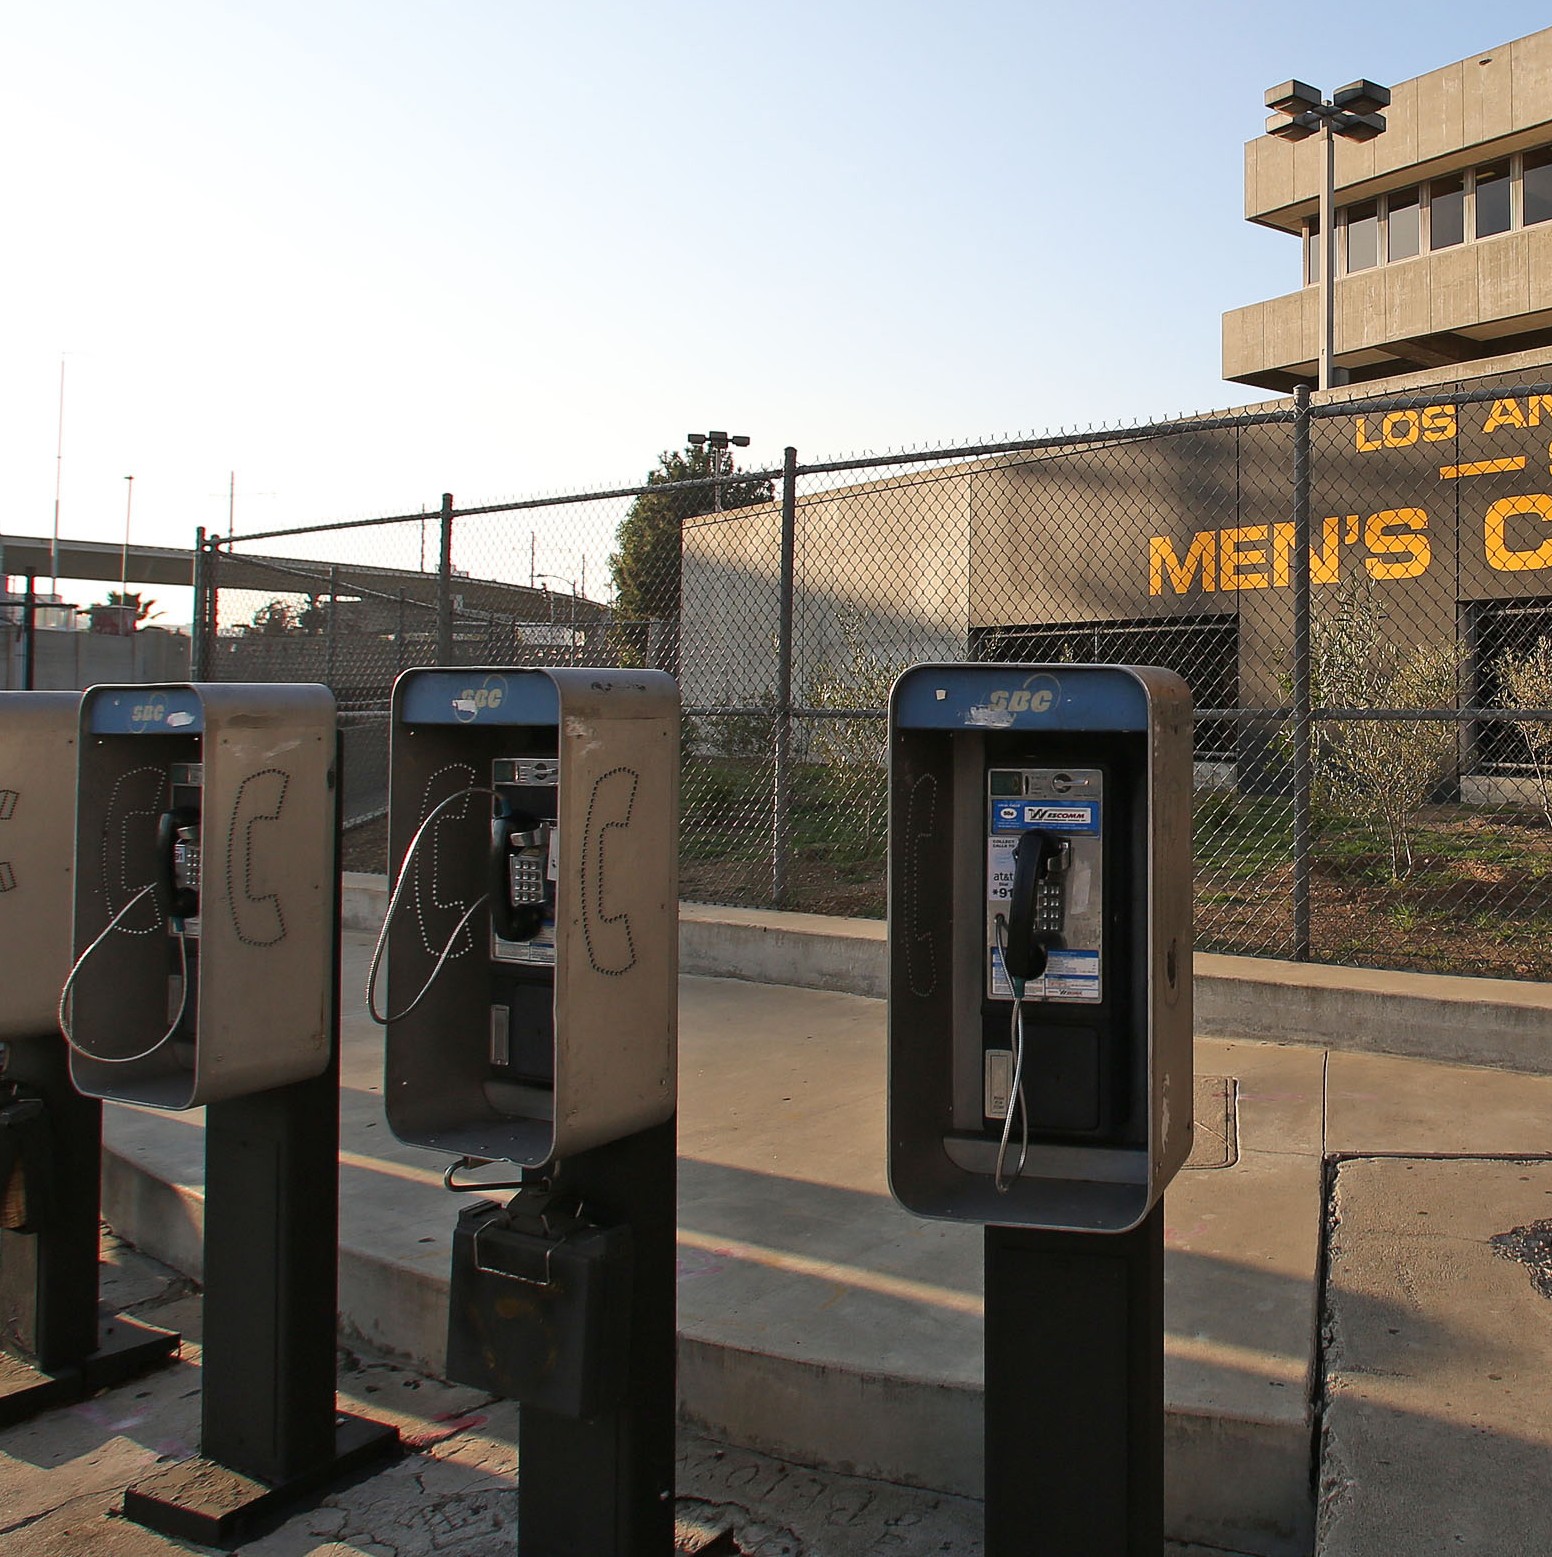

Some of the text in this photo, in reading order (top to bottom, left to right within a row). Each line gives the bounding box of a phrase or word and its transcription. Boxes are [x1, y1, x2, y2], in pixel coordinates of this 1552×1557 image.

[1357, 404, 1456, 453] LOS
[1149, 507, 1431, 595] MEN'S
[131, 705, 165, 721] SBC
[989, 690, 1053, 712] SBC
